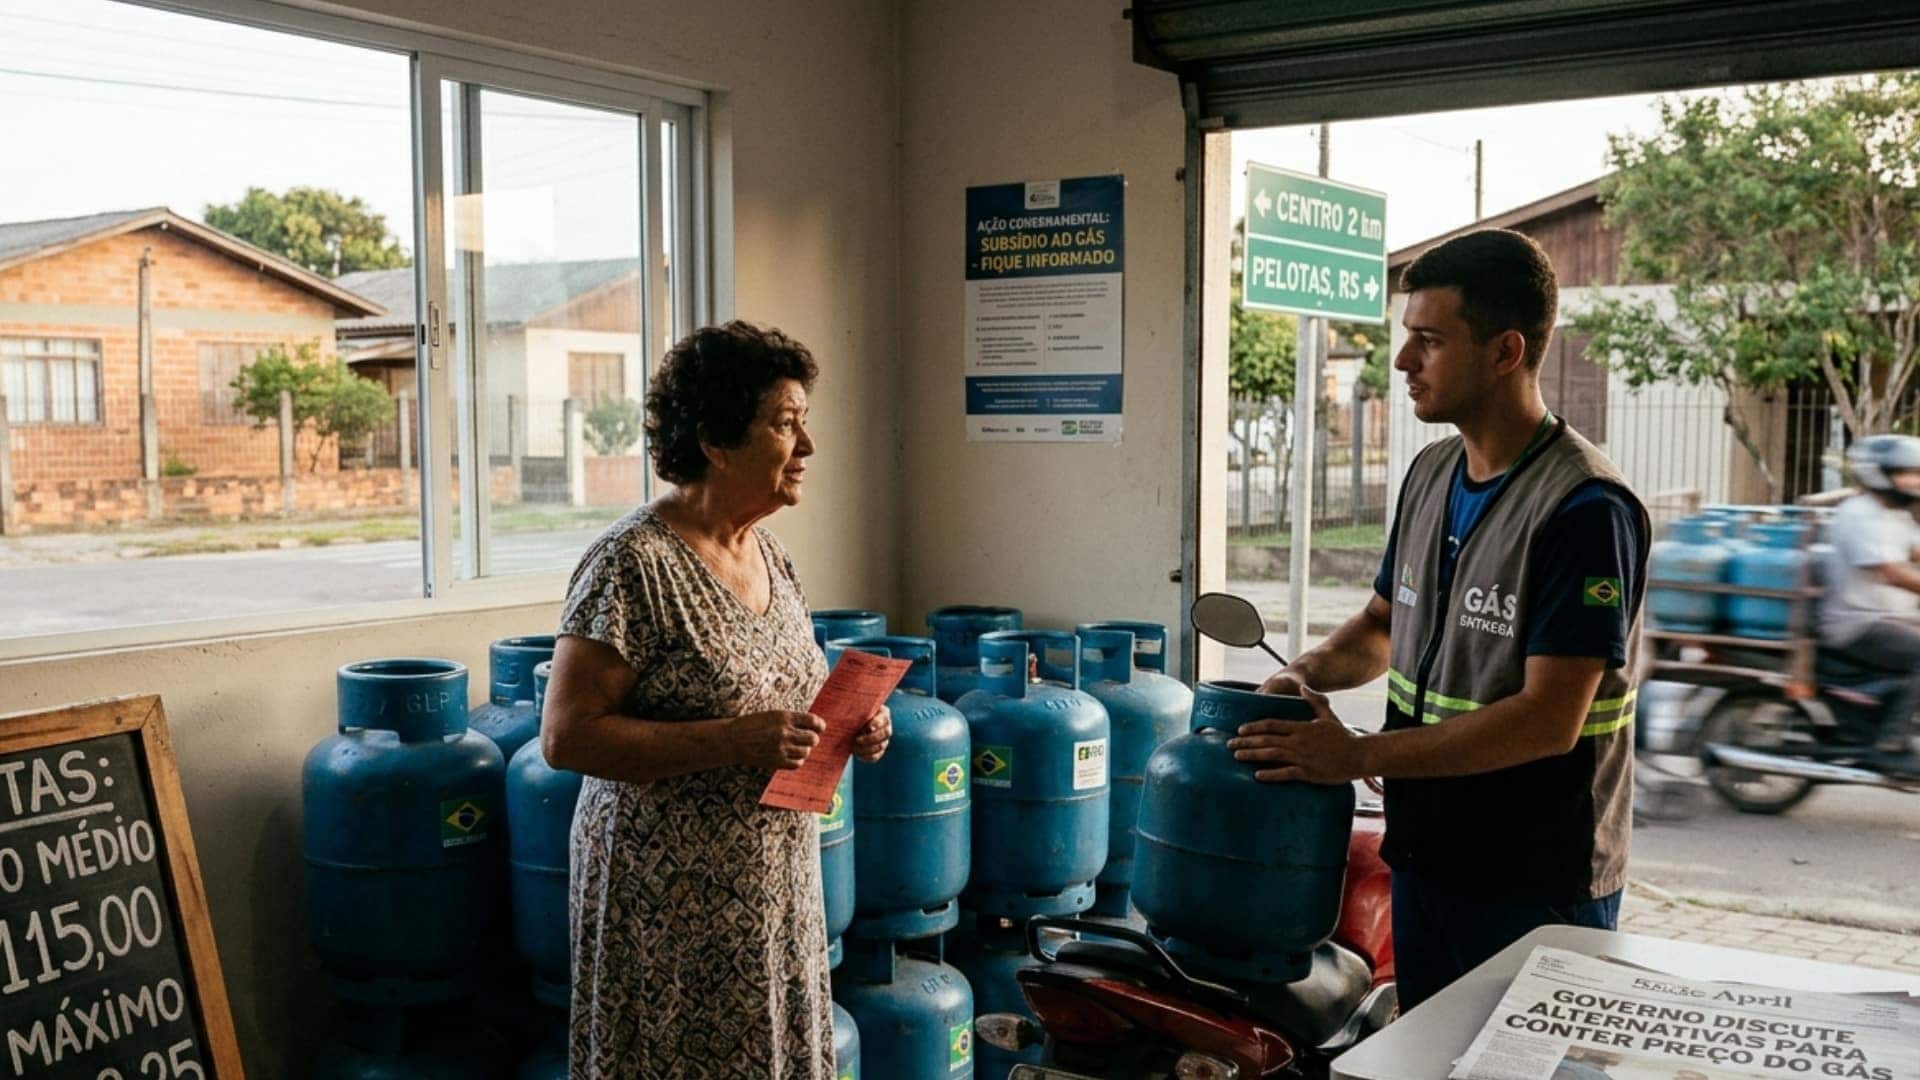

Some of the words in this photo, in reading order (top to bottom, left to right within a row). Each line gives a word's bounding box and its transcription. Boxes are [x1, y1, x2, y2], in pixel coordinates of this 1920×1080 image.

[1276, 191, 1343, 232] CENTRO
[1347, 207, 1358, 236] 2
[981, 232, 1048, 252] SUBSÍDIO
[1075, 227, 1105, 246] GÁS
[981, 255, 1023, 273] FIQUE
[1026, 249, 1115, 269] INFORMADO
[1252, 256, 1335, 299] PELOTAS,
[1339, 269, 1360, 300] RS
[1464, 583, 1517, 621] GÁS
[36, 815, 156, 885] MÉDIO
[1553, 989, 1705, 1025] GOVERNO
[1713, 1014, 1857, 1045] DISCUTE
[1712, 990, 1793, 1009] April
[7, 977, 184, 1076] MÁXIMO
[1505, 1014, 1634, 1049] CONTER
[1642, 1037, 1754, 1065] PREÇO
[1763, 1054, 1812, 1073] DO
[1820, 1061, 1893, 1080] GÁS
[1527, 1001, 1767, 1050] ALTERNATIVAS
[1775, 1038, 1868, 1063] PARA
